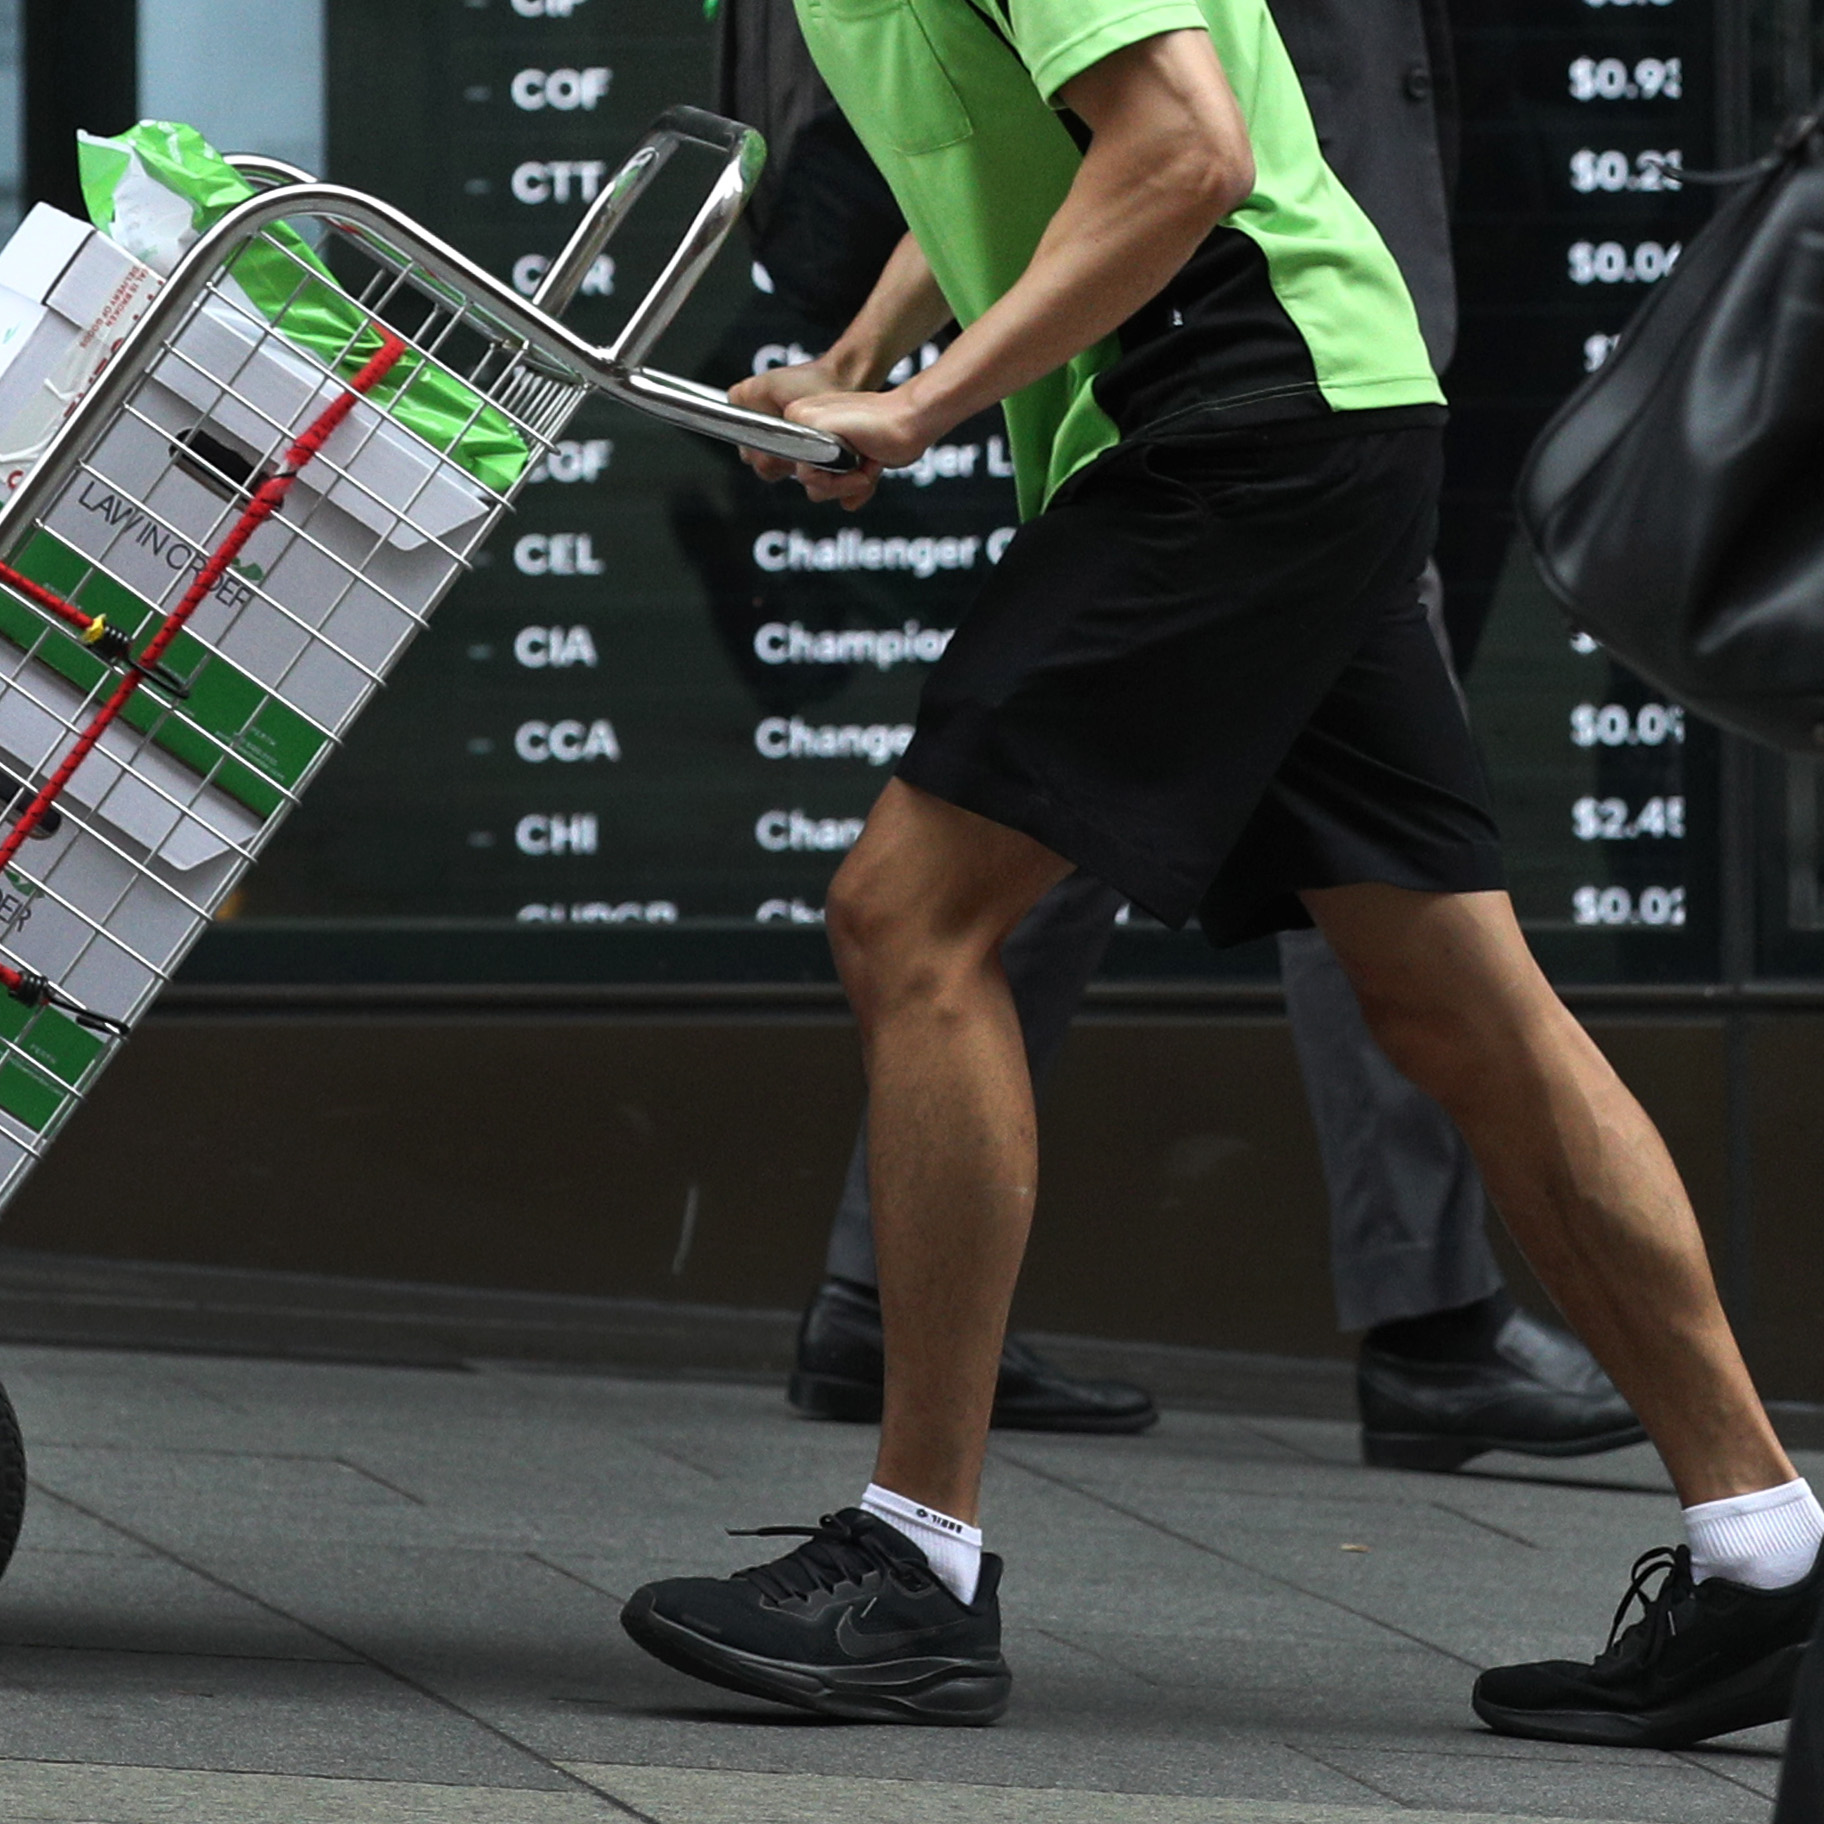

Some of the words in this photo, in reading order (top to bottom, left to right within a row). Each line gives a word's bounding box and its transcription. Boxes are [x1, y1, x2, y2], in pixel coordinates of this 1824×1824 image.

[511, 68, 612, 111] COF
[511, 160, 607, 204] CTT
[80, 482, 141, 535] LAW
[138, 523, 168, 553] IN
[513, 533, 602, 576] CEL
[753, 529, 977, 577] Challenger
[514, 625, 596, 668] CIA
[514, 719, 621, 763] CCA
[515, 812, 598, 856] CHI
